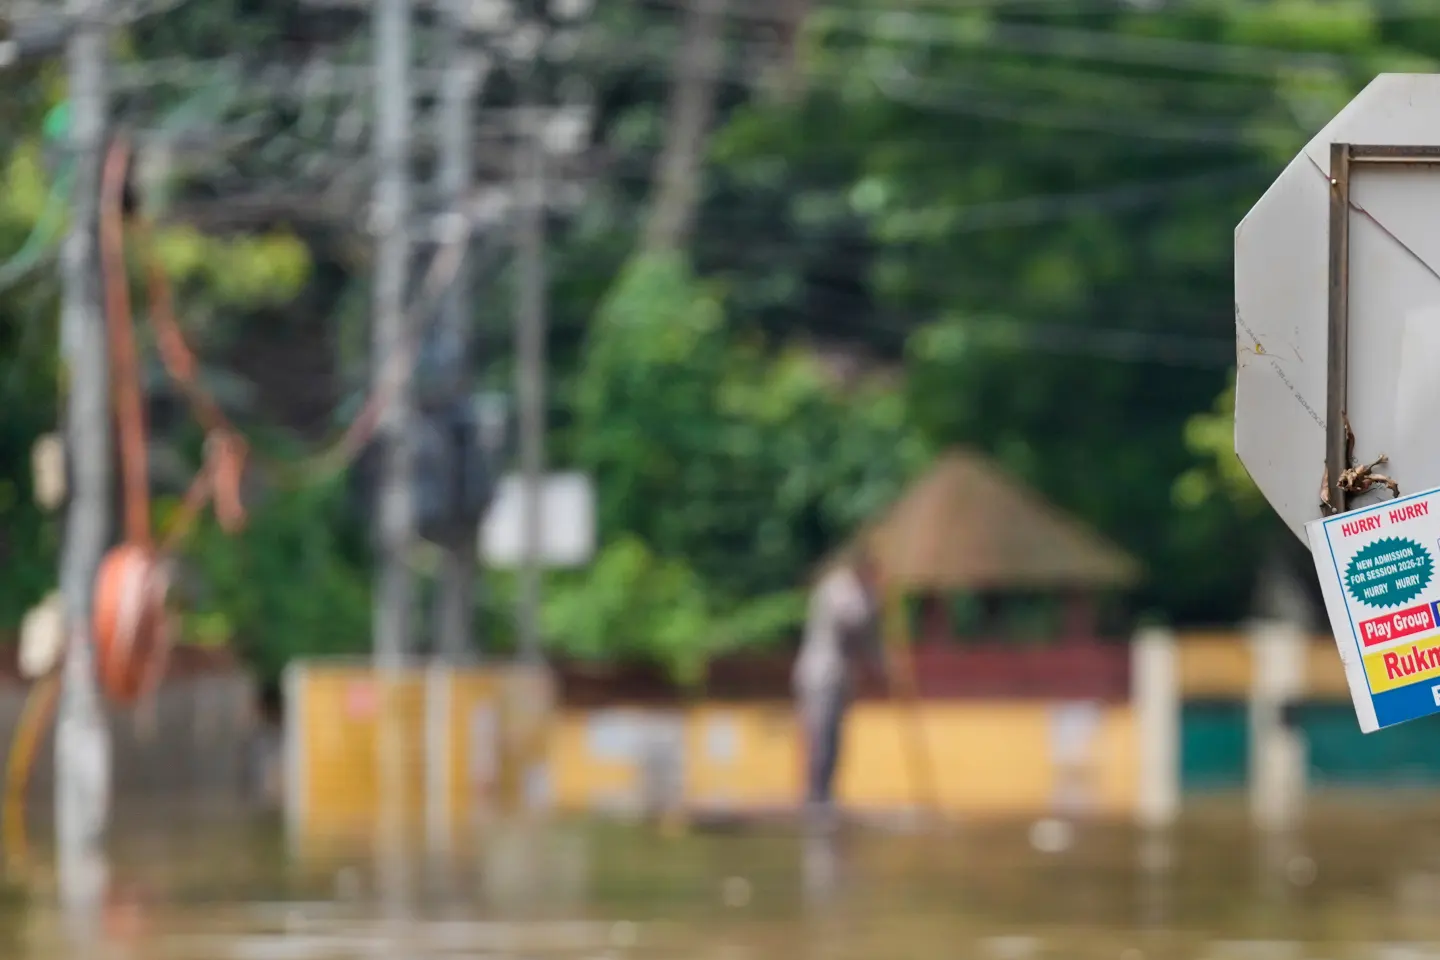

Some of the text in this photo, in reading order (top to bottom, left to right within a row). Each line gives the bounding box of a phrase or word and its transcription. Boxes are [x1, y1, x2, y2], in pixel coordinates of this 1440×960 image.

[1342, 501, 1428, 537] HURRY HURRY
[1350, 556, 1425, 584] FOR SESSION 2026-27
[1356, 547, 1413, 570] NEW ADMISSION
[1363, 574, 1420, 598] HURRY HURRY
[1365, 611, 1429, 640] Play Group
